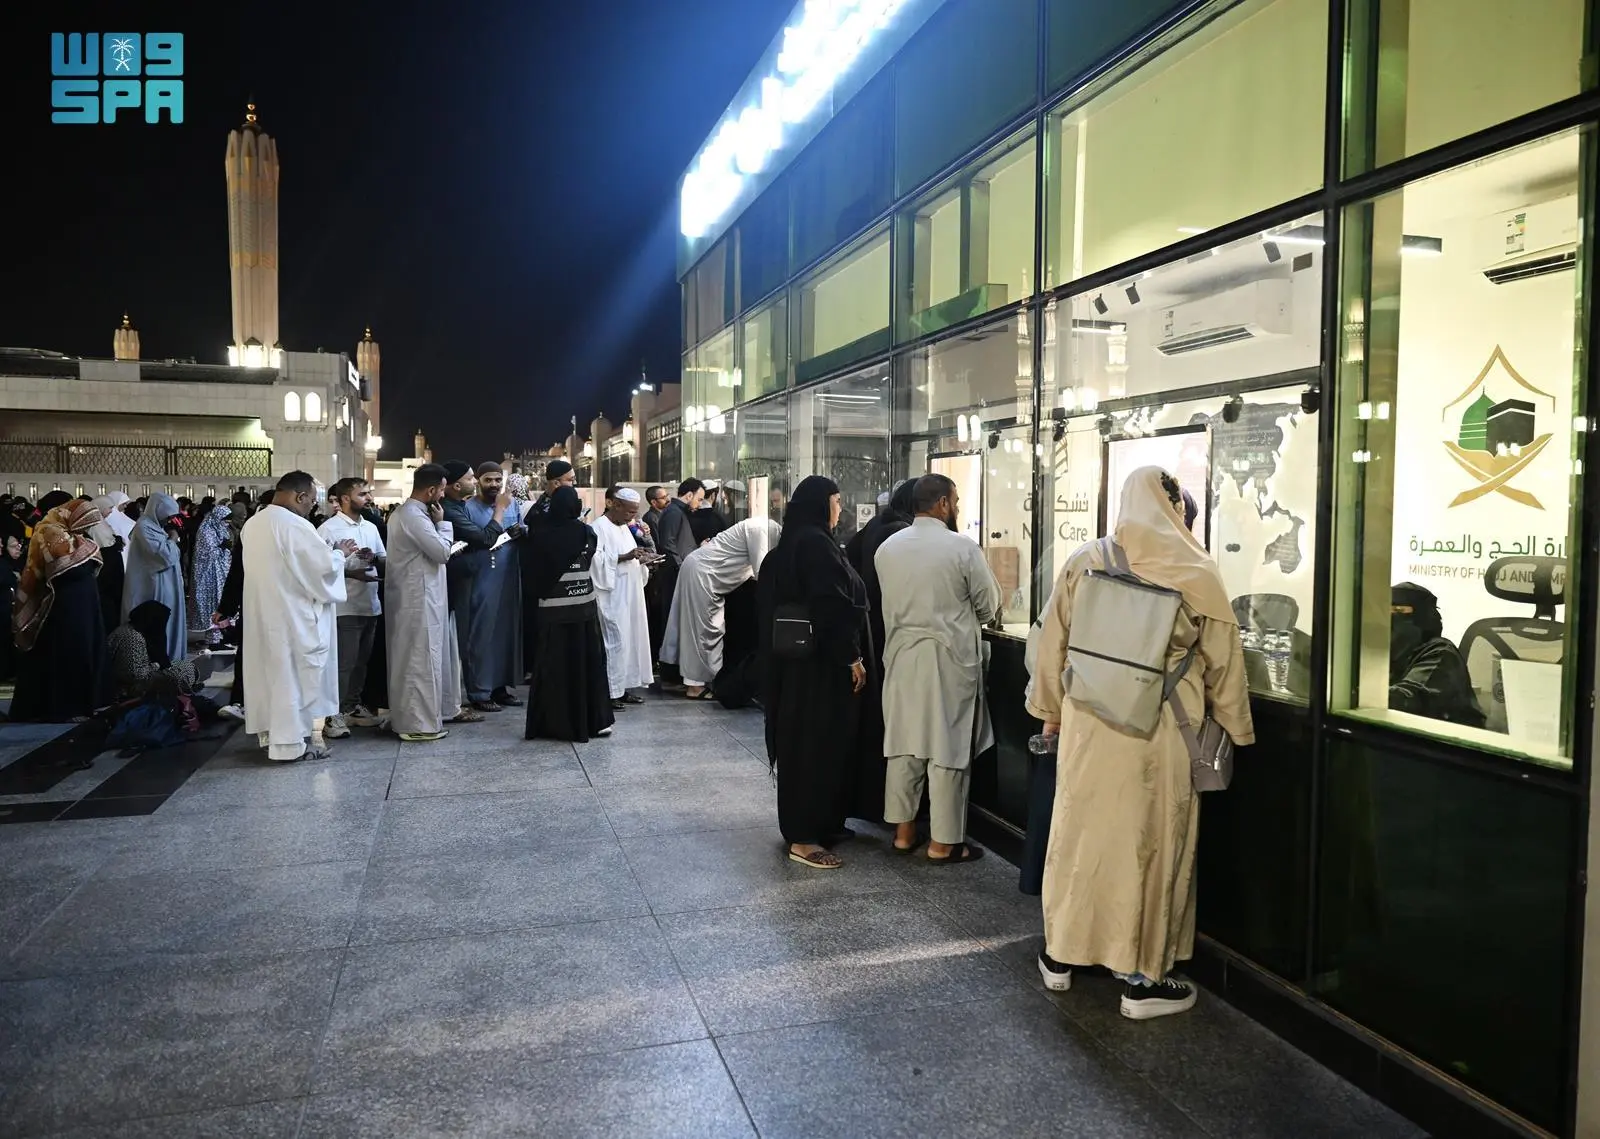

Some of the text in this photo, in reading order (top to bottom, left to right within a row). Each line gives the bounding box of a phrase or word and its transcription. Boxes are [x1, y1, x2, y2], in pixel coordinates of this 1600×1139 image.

[1059, 521, 1088, 542] Care
[1409, 534, 1482, 559] والعمرة
[1488, 535, 1536, 559] الحج
[1408, 563, 1458, 578] MINISTRY
[1460, 566, 1475, 579] OF
[1477, 567, 1507, 582] HJJ
[1510, 570, 1536, 583] AND
